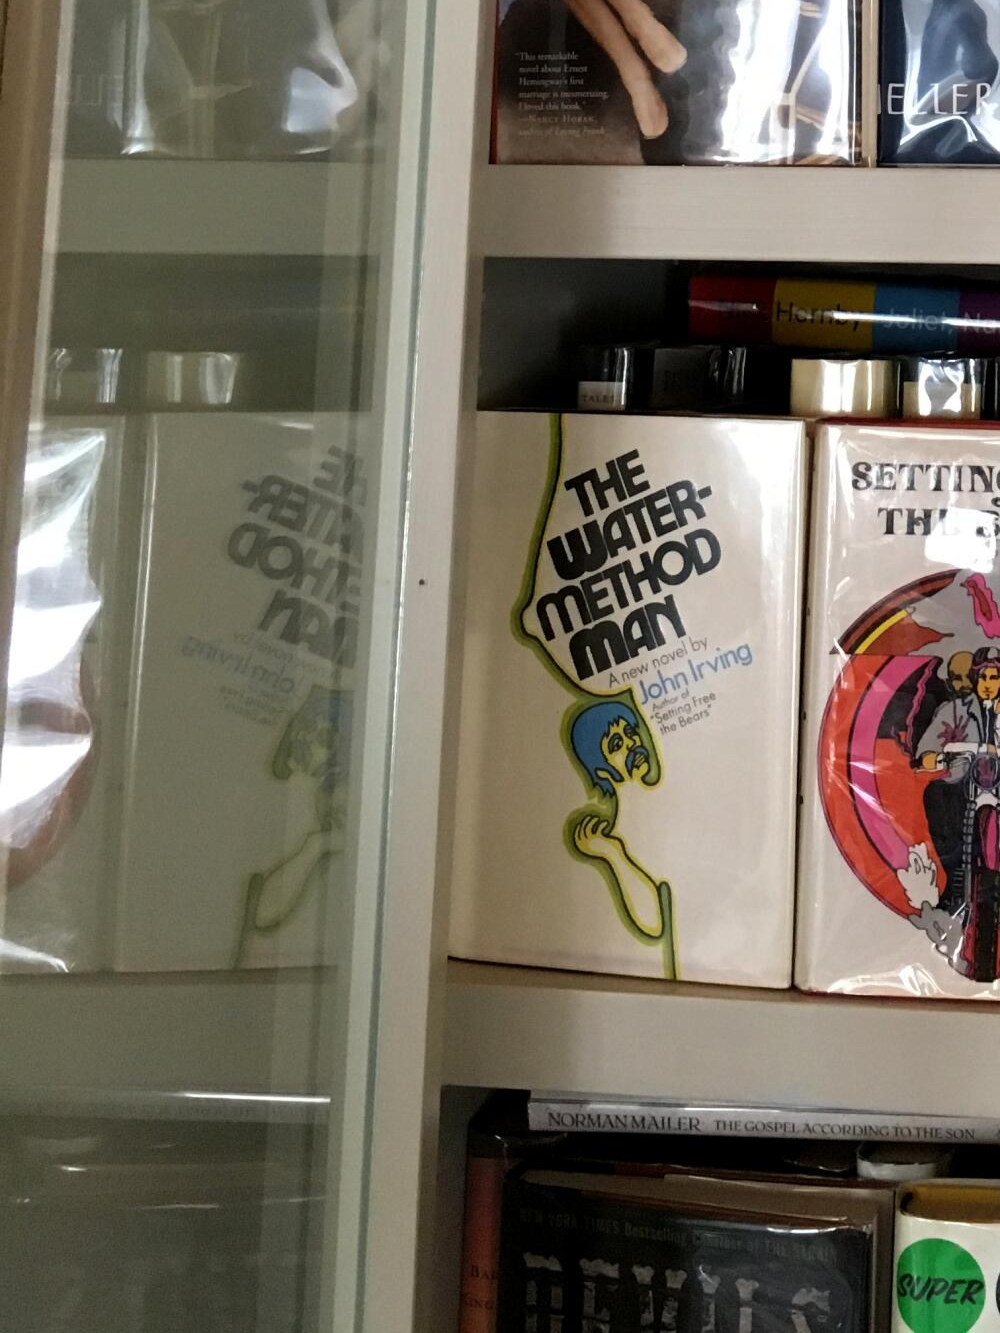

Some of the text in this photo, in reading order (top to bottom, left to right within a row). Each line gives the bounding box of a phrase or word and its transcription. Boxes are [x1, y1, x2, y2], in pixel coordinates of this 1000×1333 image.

[776, 301, 863, 332] Hornby
[564, 449, 650, 517] THE
[547, 480, 712, 580] WATER-
[536, 528, 722, 642] METHOD
[569, 594, 687, 681] MAN
[609, 636, 709, 688] A new novel by
[638, 643, 754, 706] John Irving
[692, 691, 717, 709] Free
[659, 723, 678, 736] the
[547, 1112, 701, 1132] NORMAN MAILER
[714, 1119, 975, 1140] THE GOSPEL ACCORDING TO THE SON
[898, 1274, 986, 1306] SUPER
